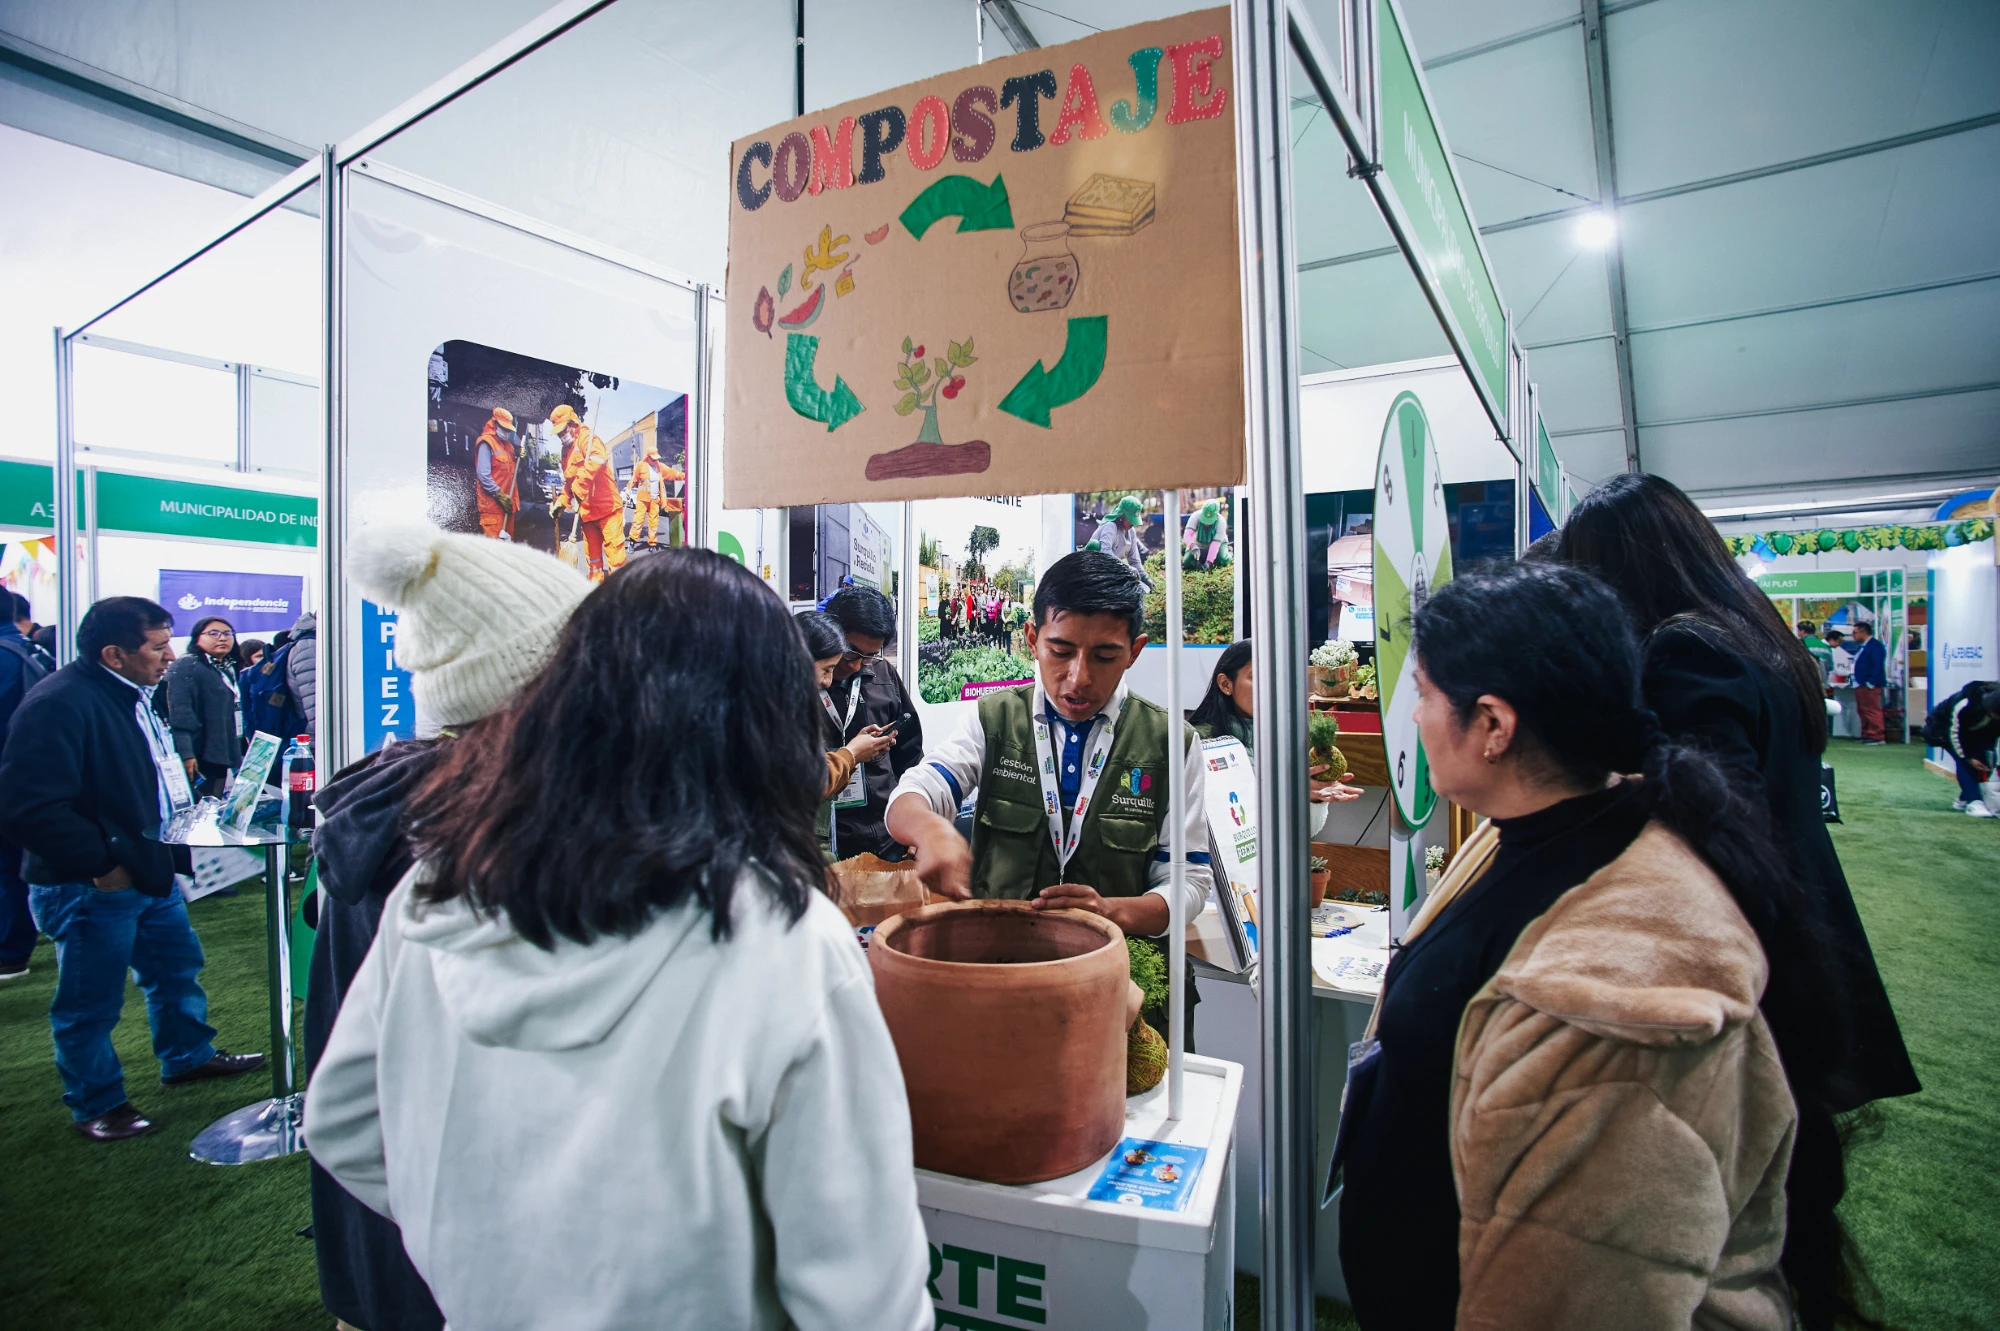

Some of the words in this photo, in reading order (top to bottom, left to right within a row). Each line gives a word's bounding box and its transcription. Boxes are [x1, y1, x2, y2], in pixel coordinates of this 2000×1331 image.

[737, 35, 1228, 211] COMPOSTAJE
[160, 500, 276, 523] MUNICIPALIDAD
[279, 513, 297, 525] DE
[204, 597, 289, 610] Independencia
[999, 756, 1033, 773] Gestión
[993, 768, 1036, 785] Ambiental
